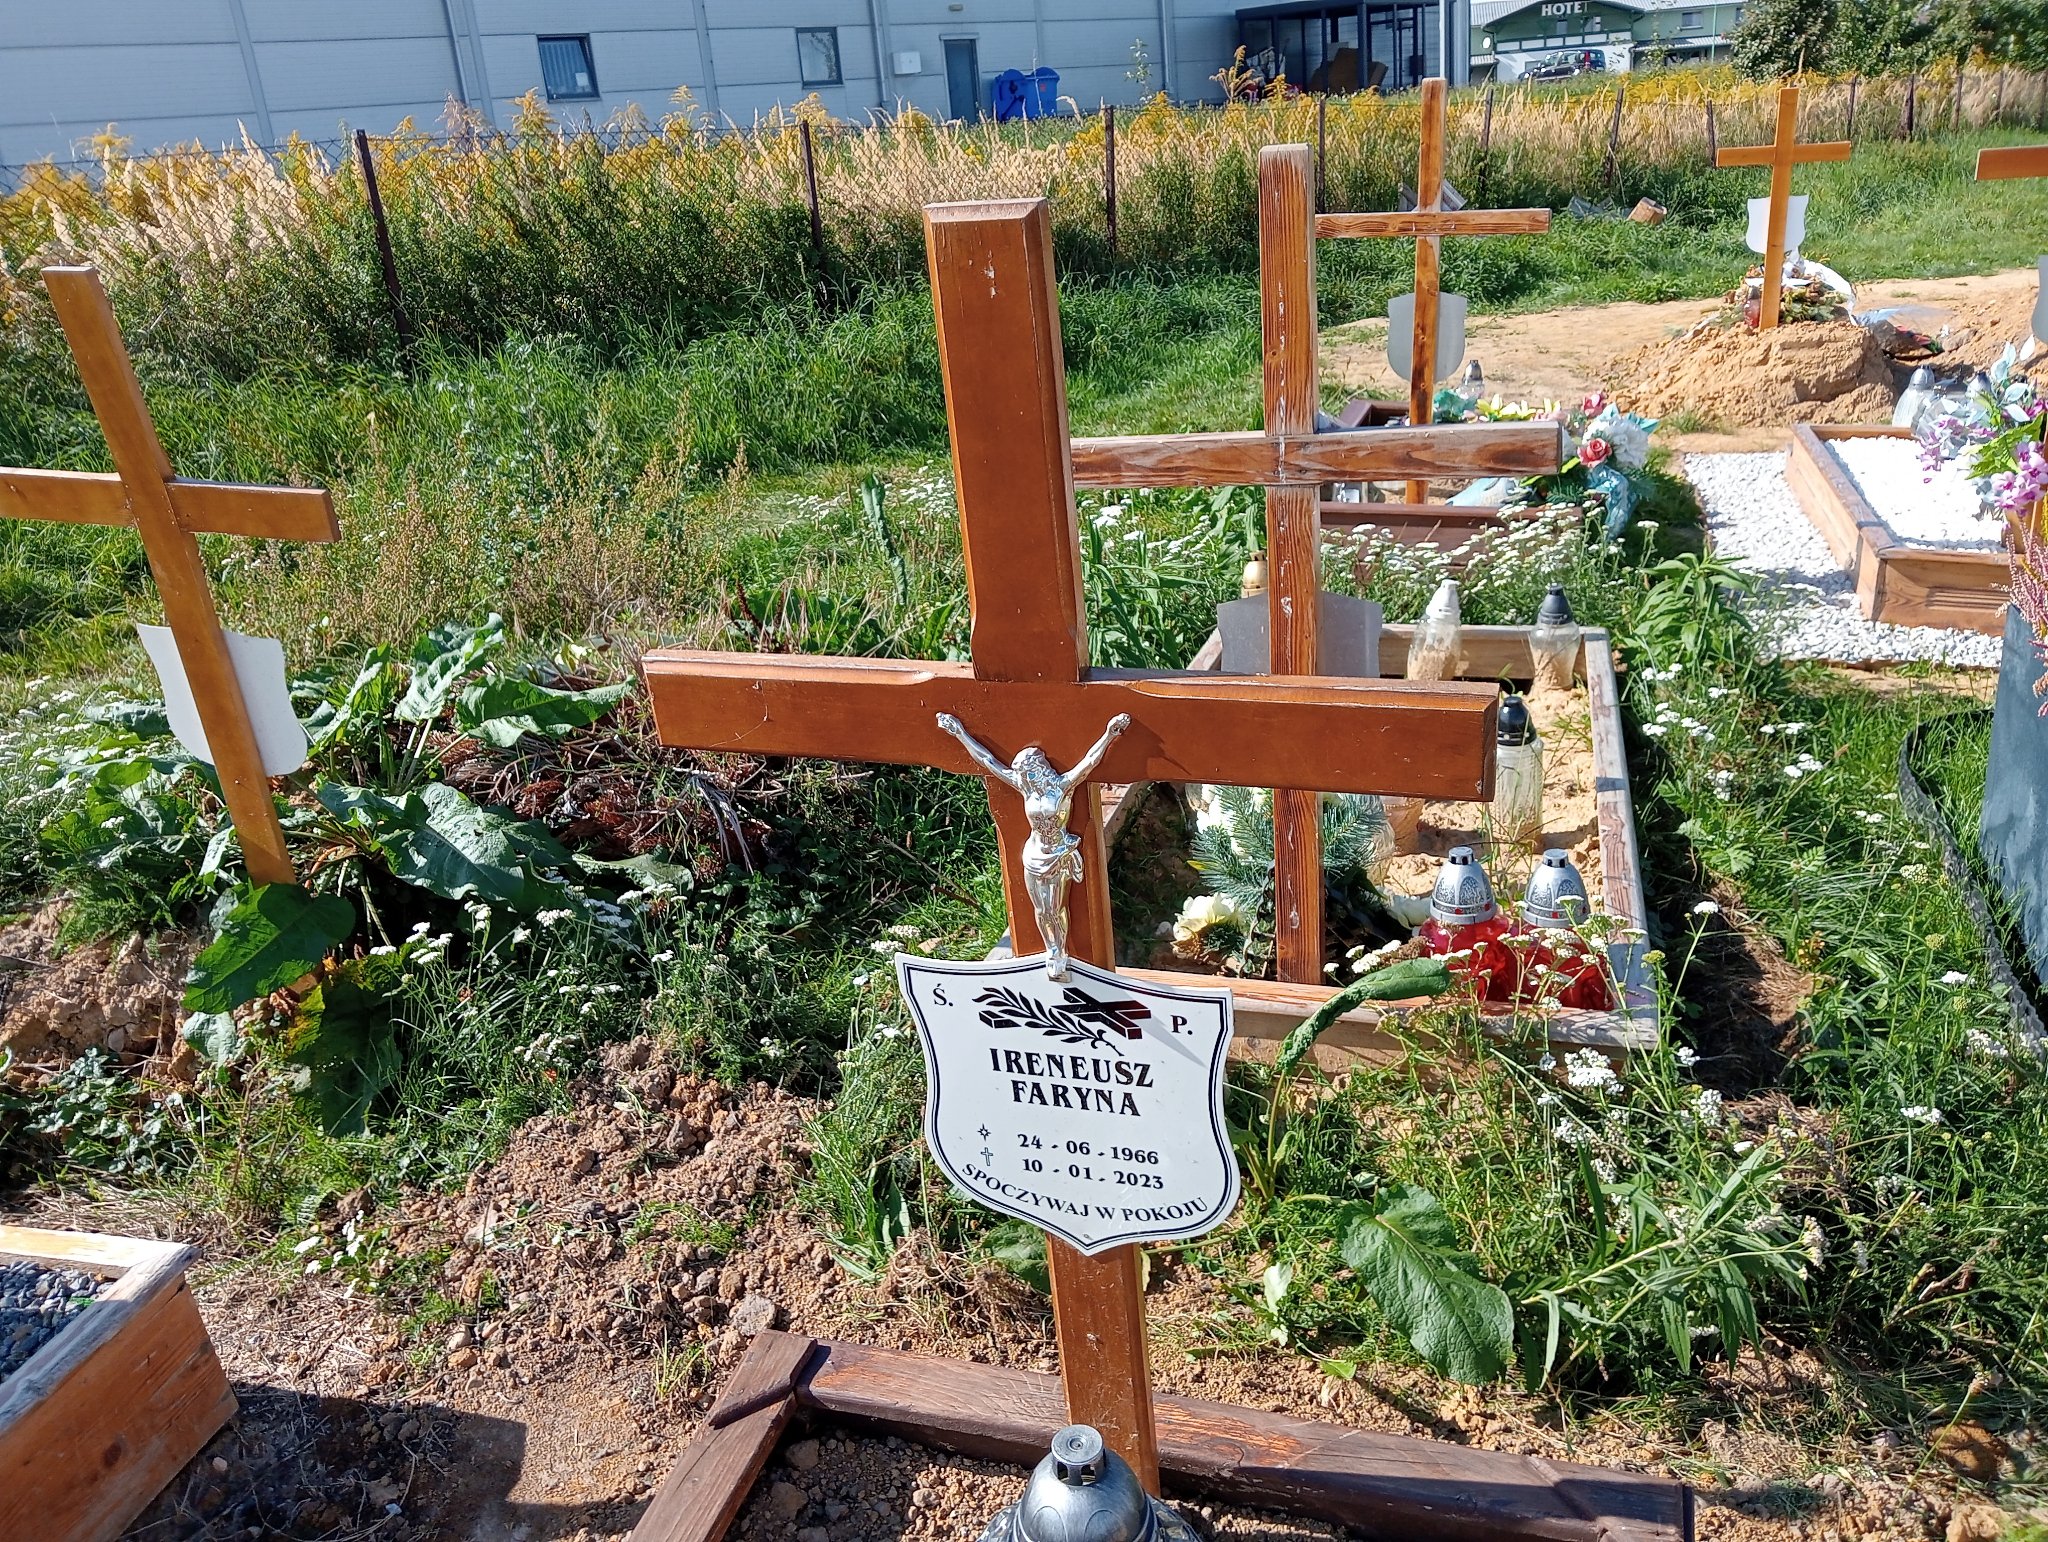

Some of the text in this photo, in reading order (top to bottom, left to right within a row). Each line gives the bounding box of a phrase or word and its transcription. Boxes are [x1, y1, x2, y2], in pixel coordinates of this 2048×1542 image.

[933, 983, 1192, 1035] Ś. P.
[990, 1048, 1153, 1088] IRENEUSZ
[1011, 1080, 1140, 1116] FARYNA
[962, 1164, 1207, 1221] SPOCZYWAJ W POKOJU
